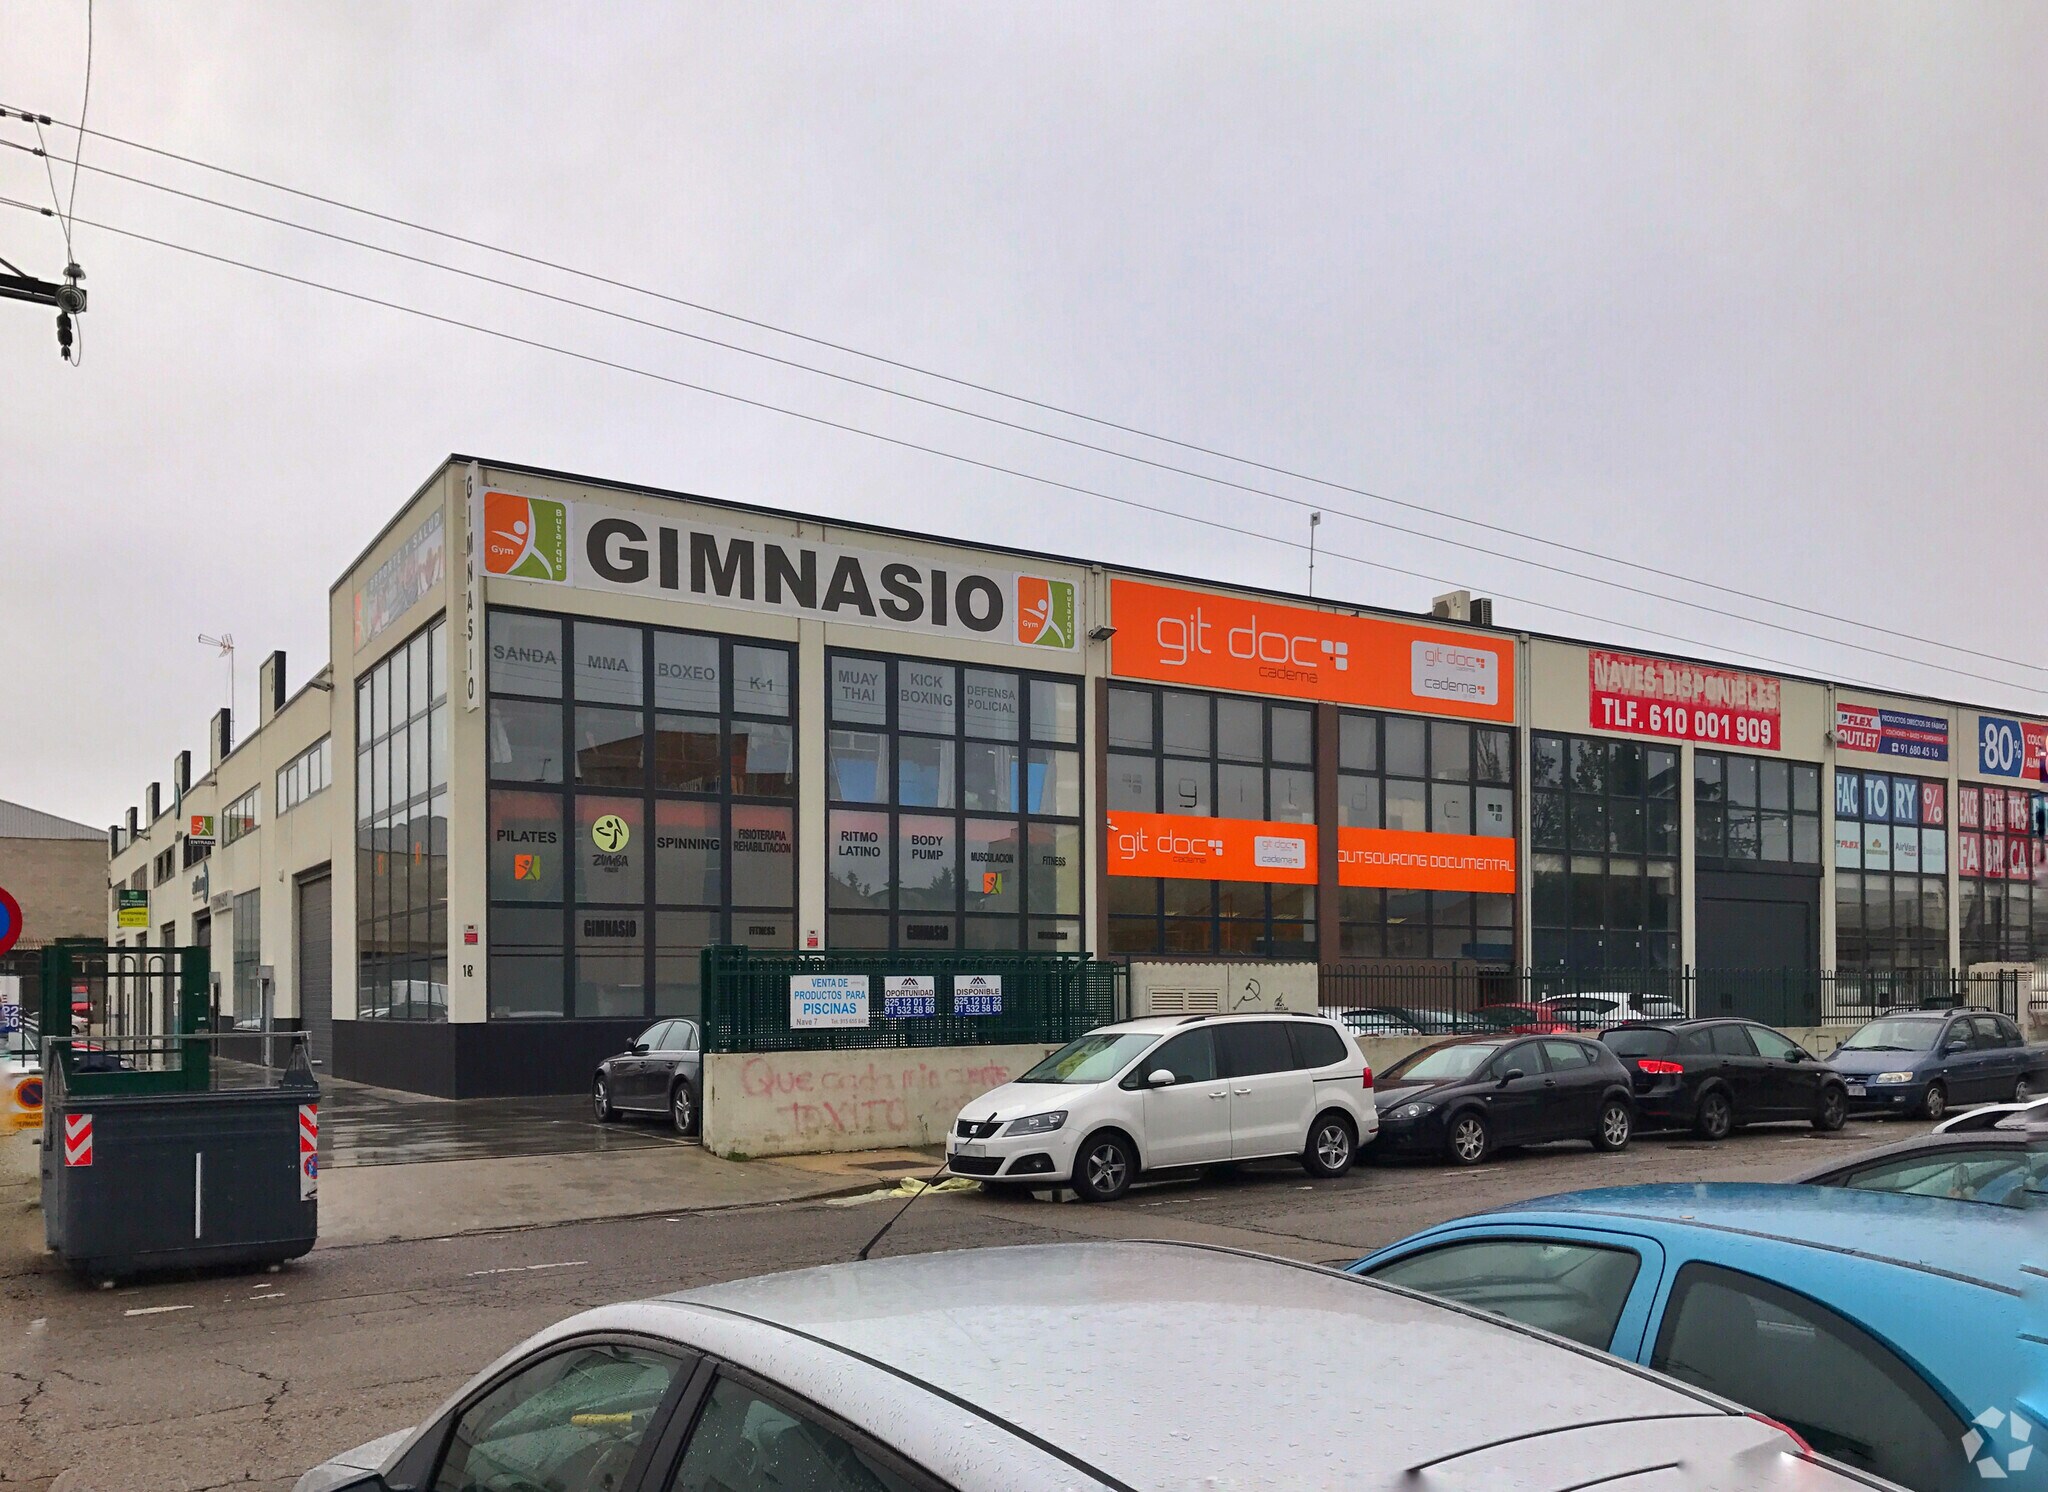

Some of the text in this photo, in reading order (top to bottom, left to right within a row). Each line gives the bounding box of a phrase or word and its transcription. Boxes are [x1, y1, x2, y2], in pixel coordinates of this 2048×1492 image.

[413, 512, 440, 549] SALUD
[555, 509, 563, 571] Butarque
[491, 544, 514, 555] Gym
[586, 518, 1004, 632] GIMNASIO
[466, 475, 474, 700] GIMNASIO
[1022, 619, 1039, 629] Gym
[1157, 607, 1318, 667] git doc
[493, 645, 557, 665] SANDA
[1425, 647, 1475, 668] git doc
[588, 655, 629, 672] MMA
[658, 663, 715, 681] BOXEO
[838, 670, 878, 686] MUAY
[1258, 666, 1318, 684] cadema
[750, 677, 773, 691] K-1
[910, 673, 943, 689] KICK
[1424, 677, 1477, 694] cadema
[1594, 658, 1778, 711] NAVES DISPONIBLES
[843, 686, 875, 702] THAI
[900, 689, 953, 707] BOXING
[967, 685, 1015, 700] DEFENSA
[967, 700, 1015, 714] POLICIAL
[1602, 697, 1771, 745] TLF. 610 001 909
[1848, 715, 1872, 727] FLEX
[1838, 729, 1878, 748] OUTLET
[1900, 744, 1939, 758] 91 680 45 16
[496, 829, 557, 844] PILATES
[738, 829, 786, 841] FISIOTERAPIA
[841, 831, 878, 843] RITMO
[911, 835, 943, 846] BODY
[657, 837, 720, 850] SPINNING
[733, 841, 791, 853] REHABILITACION
[1119, 827, 1206, 860] git doc
[838, 845, 880, 857] LATINO
[912, 849, 943, 860] PUMP
[971, 852, 1014, 864] MUSCULACION
[592, 854, 628, 867] ZUMBA
[1042, 856, 1066, 866] FITNESS
[1338, 850, 1514, 872] OUTSOURCING DOCUMENTAL
[583, 919, 637, 937] GIMNASIO
[748, 926, 775, 936] FITNESS
[463, 964, 474, 977] 18
[811, 979, 836, 987] VENTA
[838, 979, 848, 987] DE
[795, 991, 866, 999] PRODUCTOS PARA
[954, 997, 1002, 1005] 625 12 01 22
[803, 1003, 857, 1014] PISCINAS
[885, 998, 935, 1007] 625 12 01 22
[954, 1004, 1002, 1013] 91 532 58 80
[885, 1006, 935, 1014] 91 532 58 80
